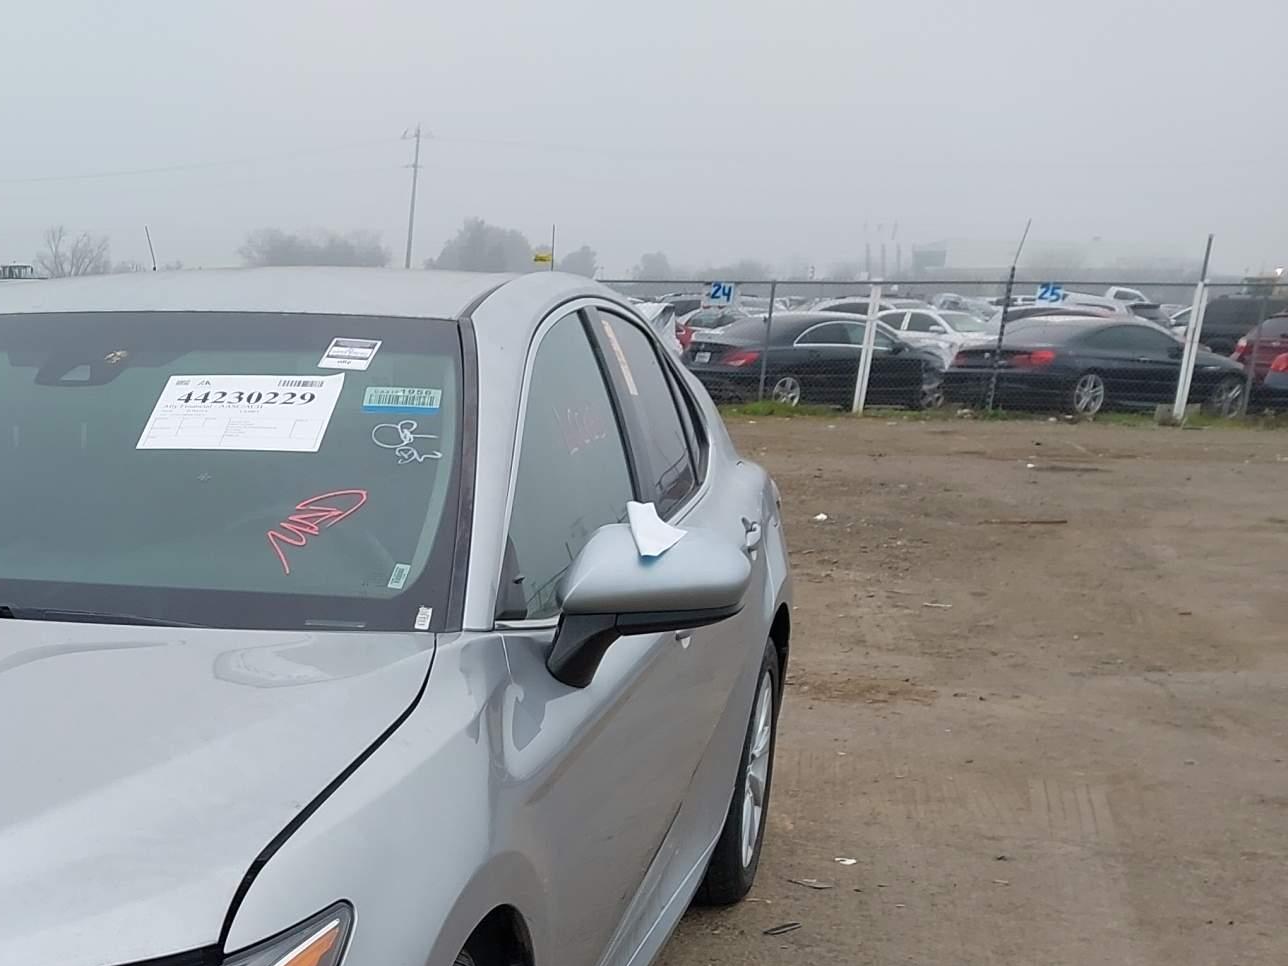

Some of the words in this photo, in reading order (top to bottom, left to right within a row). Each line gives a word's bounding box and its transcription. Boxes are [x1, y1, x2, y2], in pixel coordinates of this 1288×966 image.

[711, 282, 732, 303] 24
[1038, 283, 1061, 303] 25
[177, 390, 316, 406] 44230229
